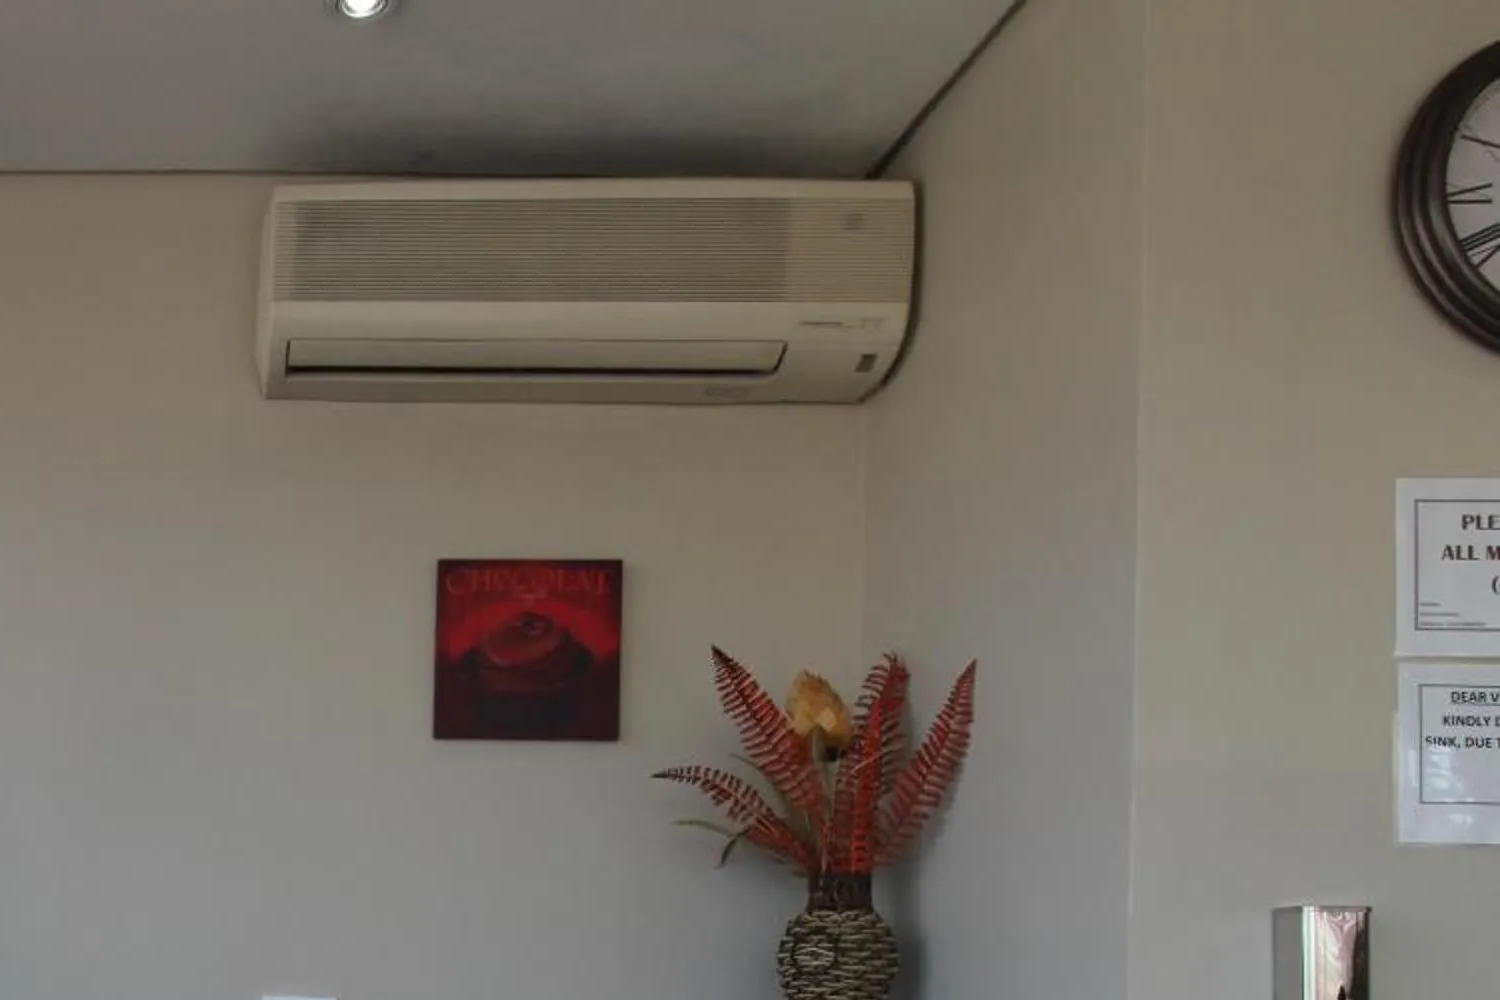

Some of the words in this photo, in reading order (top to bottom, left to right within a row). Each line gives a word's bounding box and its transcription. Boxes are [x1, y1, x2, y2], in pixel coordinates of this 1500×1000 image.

[1441, 543, 1481, 561] ALL
[1450, 691, 1486, 703] DEAR
[1443, 715, 1491, 728] KINDLY
[1425, 735, 1461, 749] SINK,
[1465, 736, 1492, 749] DUE
